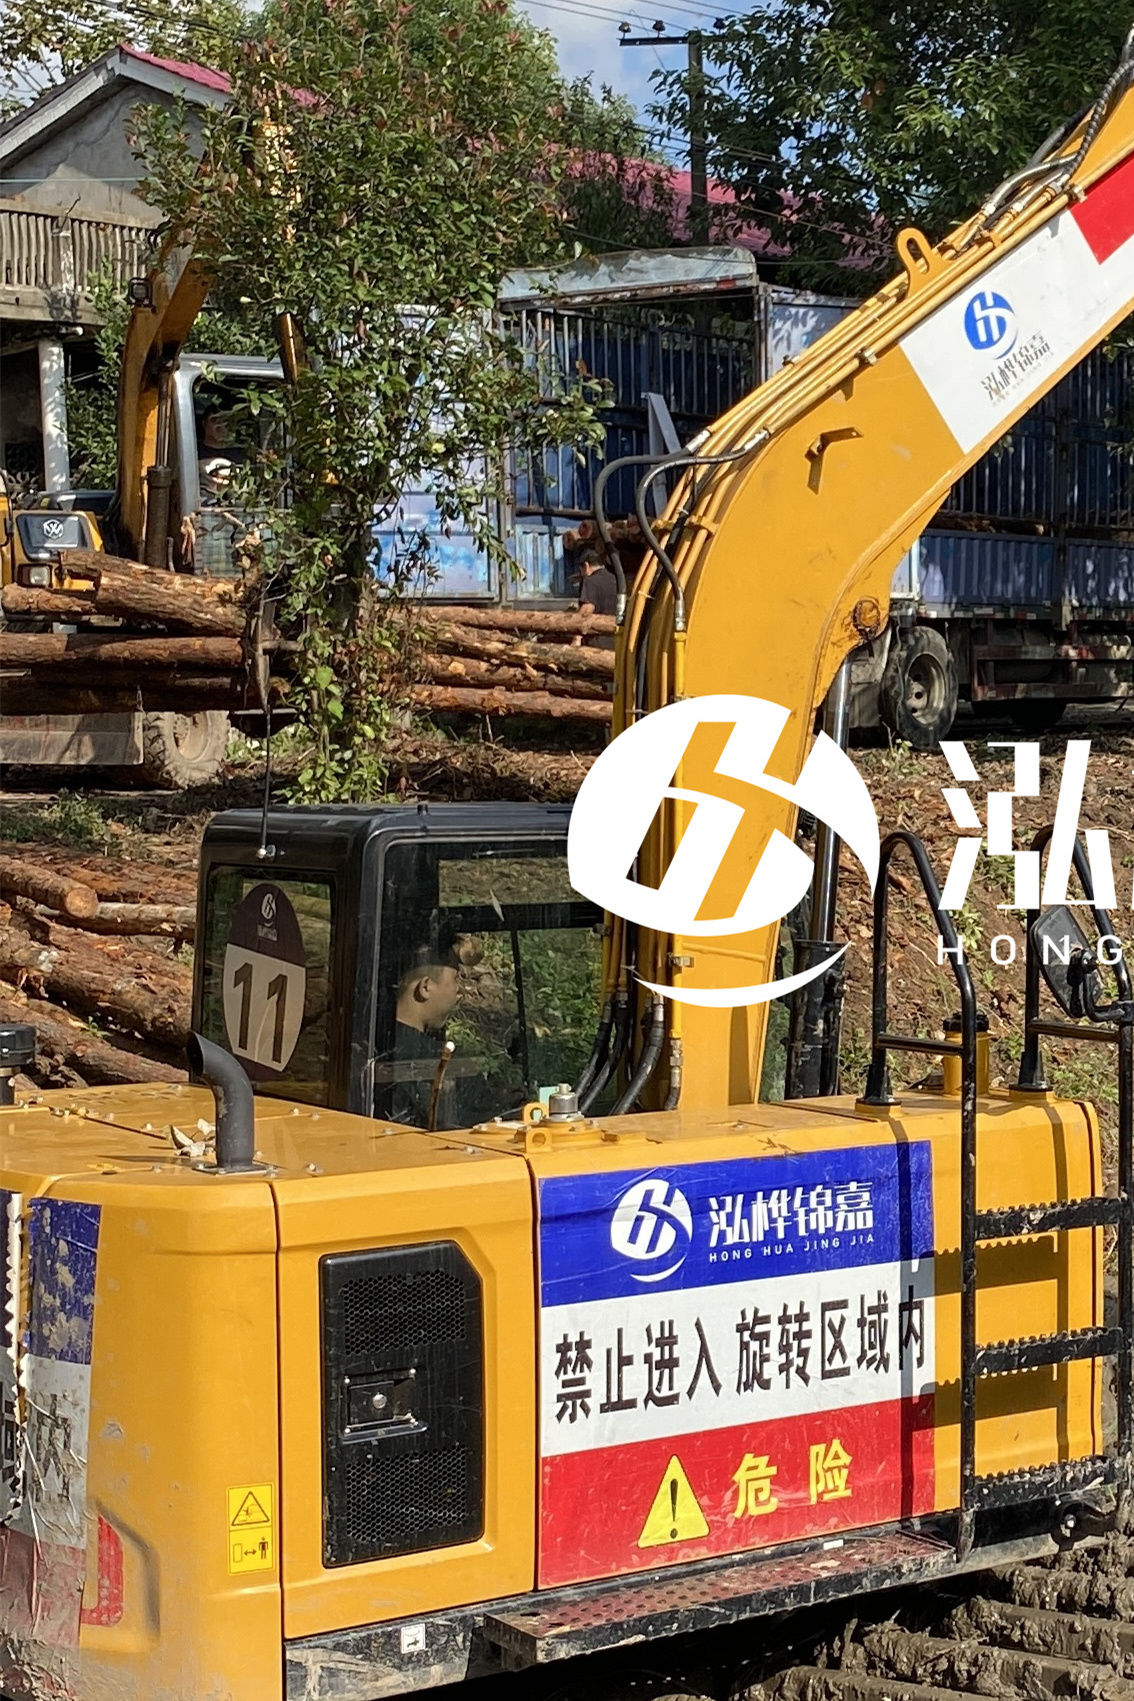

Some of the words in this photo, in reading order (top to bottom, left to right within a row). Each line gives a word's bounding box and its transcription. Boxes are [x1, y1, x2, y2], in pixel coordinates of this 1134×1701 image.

[232, 961, 288, 1065] 11
[709, 1181, 873, 1247] 泓桦锦嘉
[709, 1248, 753, 1263] HONG
[763, 1243, 794, 1256] HUA
[804, 1238, 840, 1251] JING
[850, 1233, 874, 1246] JIA
[554, 1316, 723, 1424] 禁止进入
[735, 1284, 926, 1392] 旋转区域内
[731, 1438, 853, 1518] 危险
